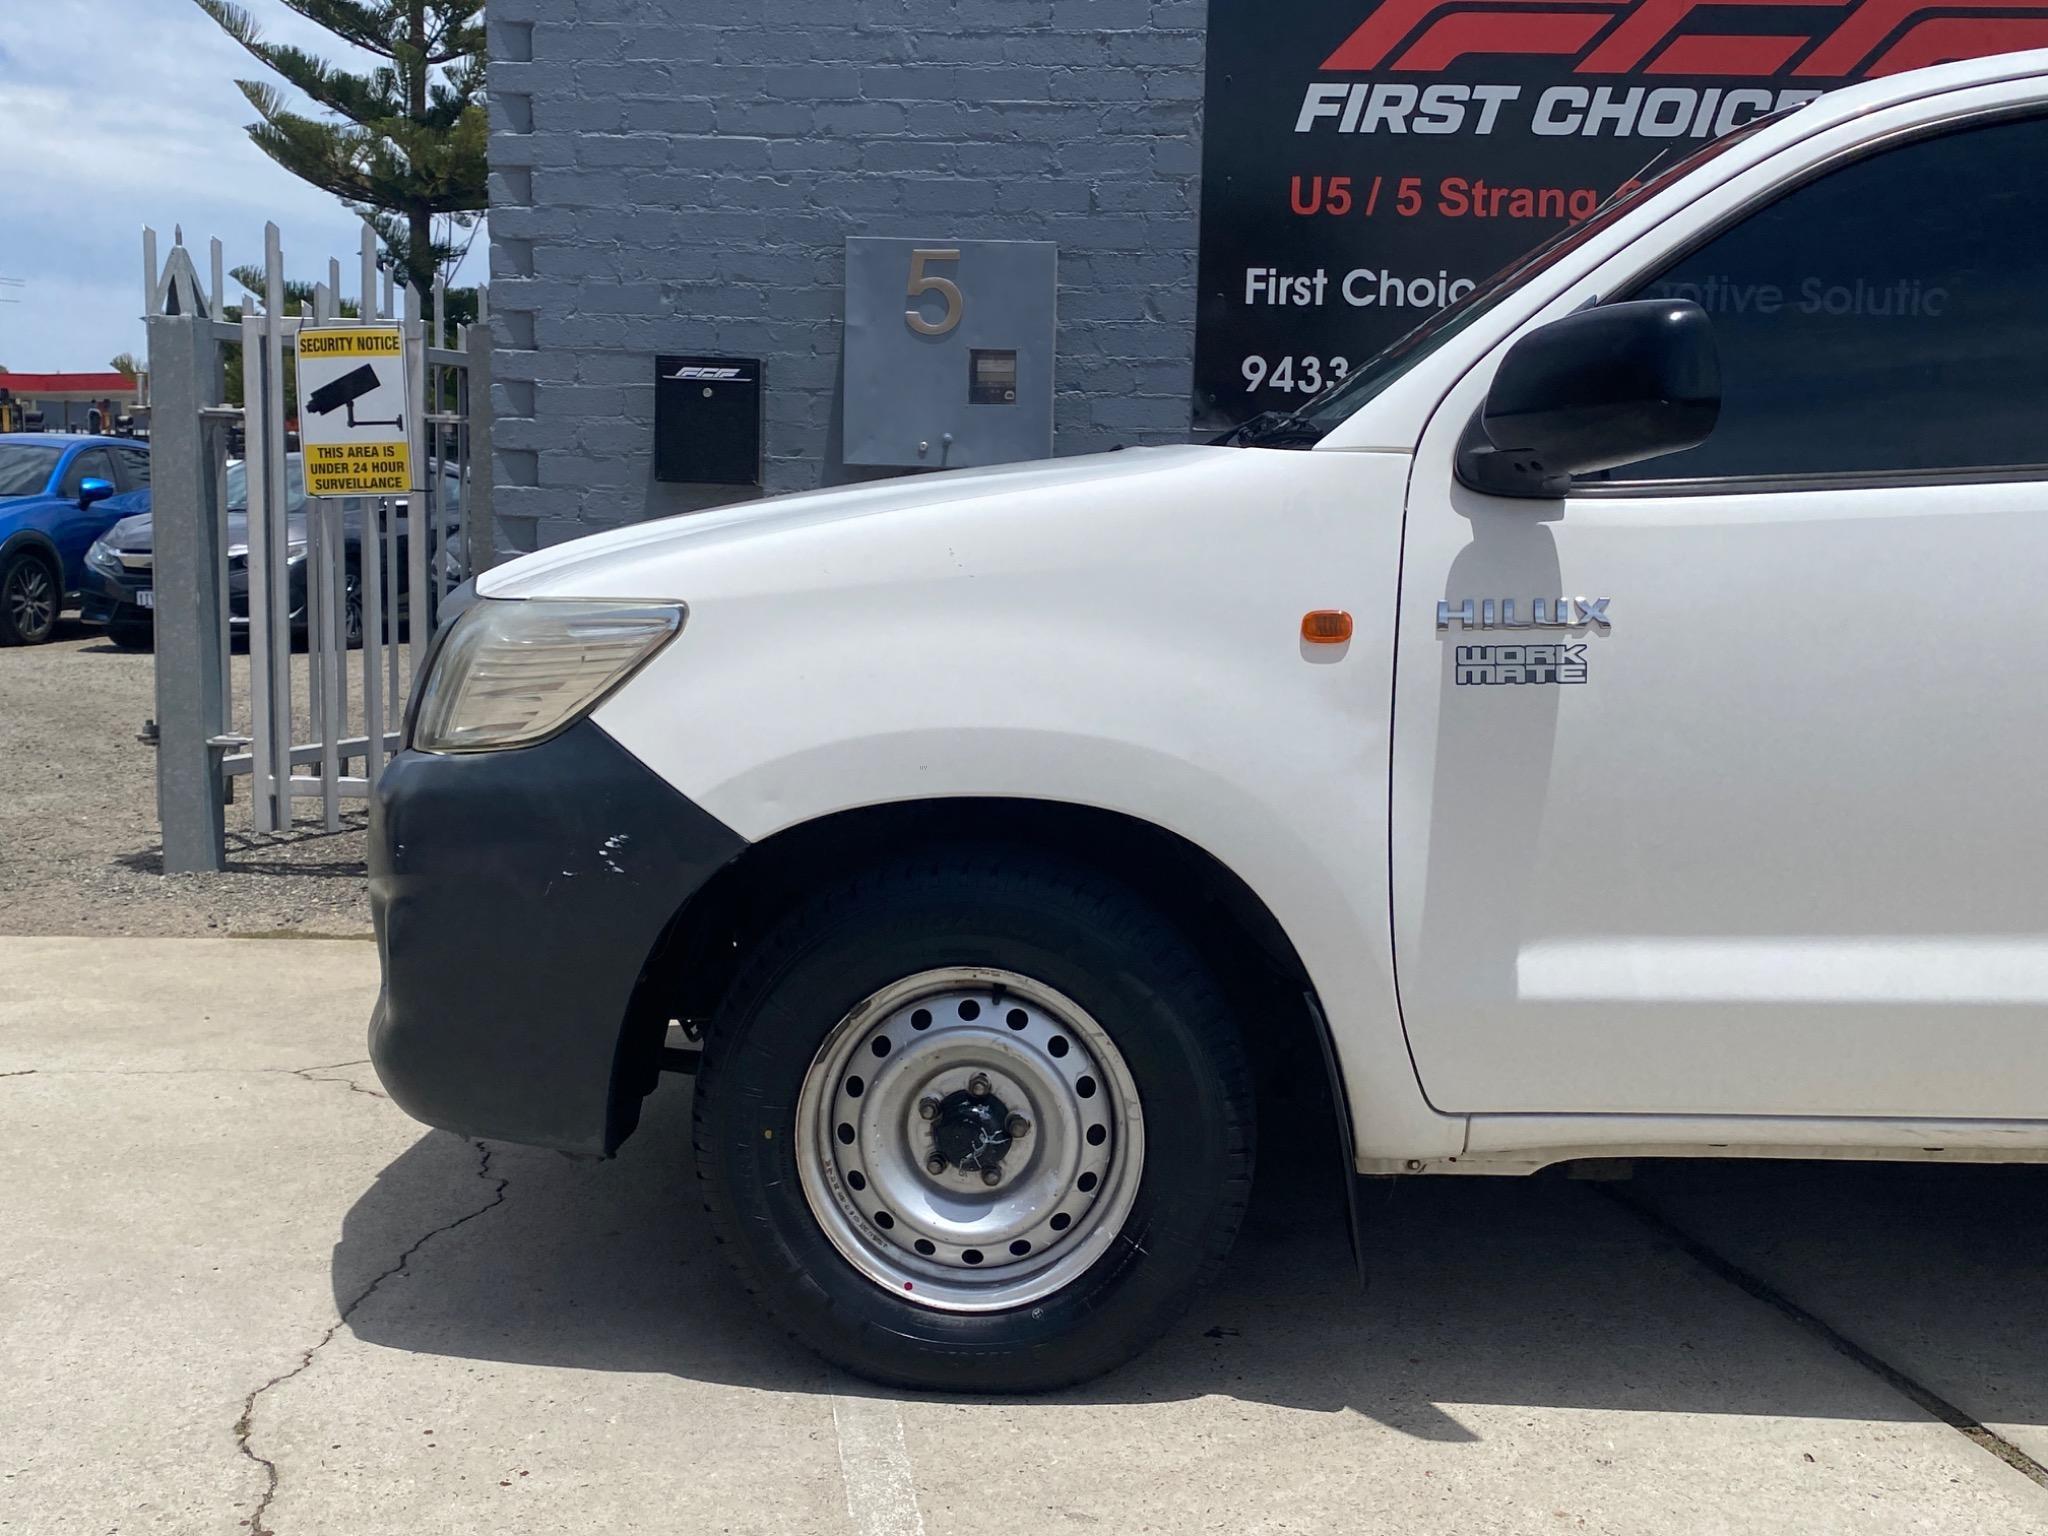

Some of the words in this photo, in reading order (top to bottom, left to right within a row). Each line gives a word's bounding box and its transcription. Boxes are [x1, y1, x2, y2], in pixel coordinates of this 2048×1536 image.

[1294, 83, 1522, 134] FIRST
[1289, 175, 1351, 216] U5
[1365, 176, 1382, 216] /
[1395, 177, 1423, 217] 5
[1437, 177, 1598, 227] Strang
[905, 249, 964, 336] 5
[1245, 268, 1329, 305] First
[300, 336, 352, 353] SECURITY
[357, 335, 400, 351] NOTICE
[1241, 354, 1349, 393] 9433
[317, 447, 344, 459] THIS
[347, 447, 379, 458] AREA
[383, 445, 395, 457] IS
[310, 463, 350, 475] UNDER
[353, 462, 368, 474] 24
[372, 461, 405, 473] HOUR
[315, 477, 403, 491] SURVEILLANCE
[1437, 597, 1611, 629] HILUX
[1456, 644, 1588, 665] WORK
[1456, 664, 1588, 685] MATE
